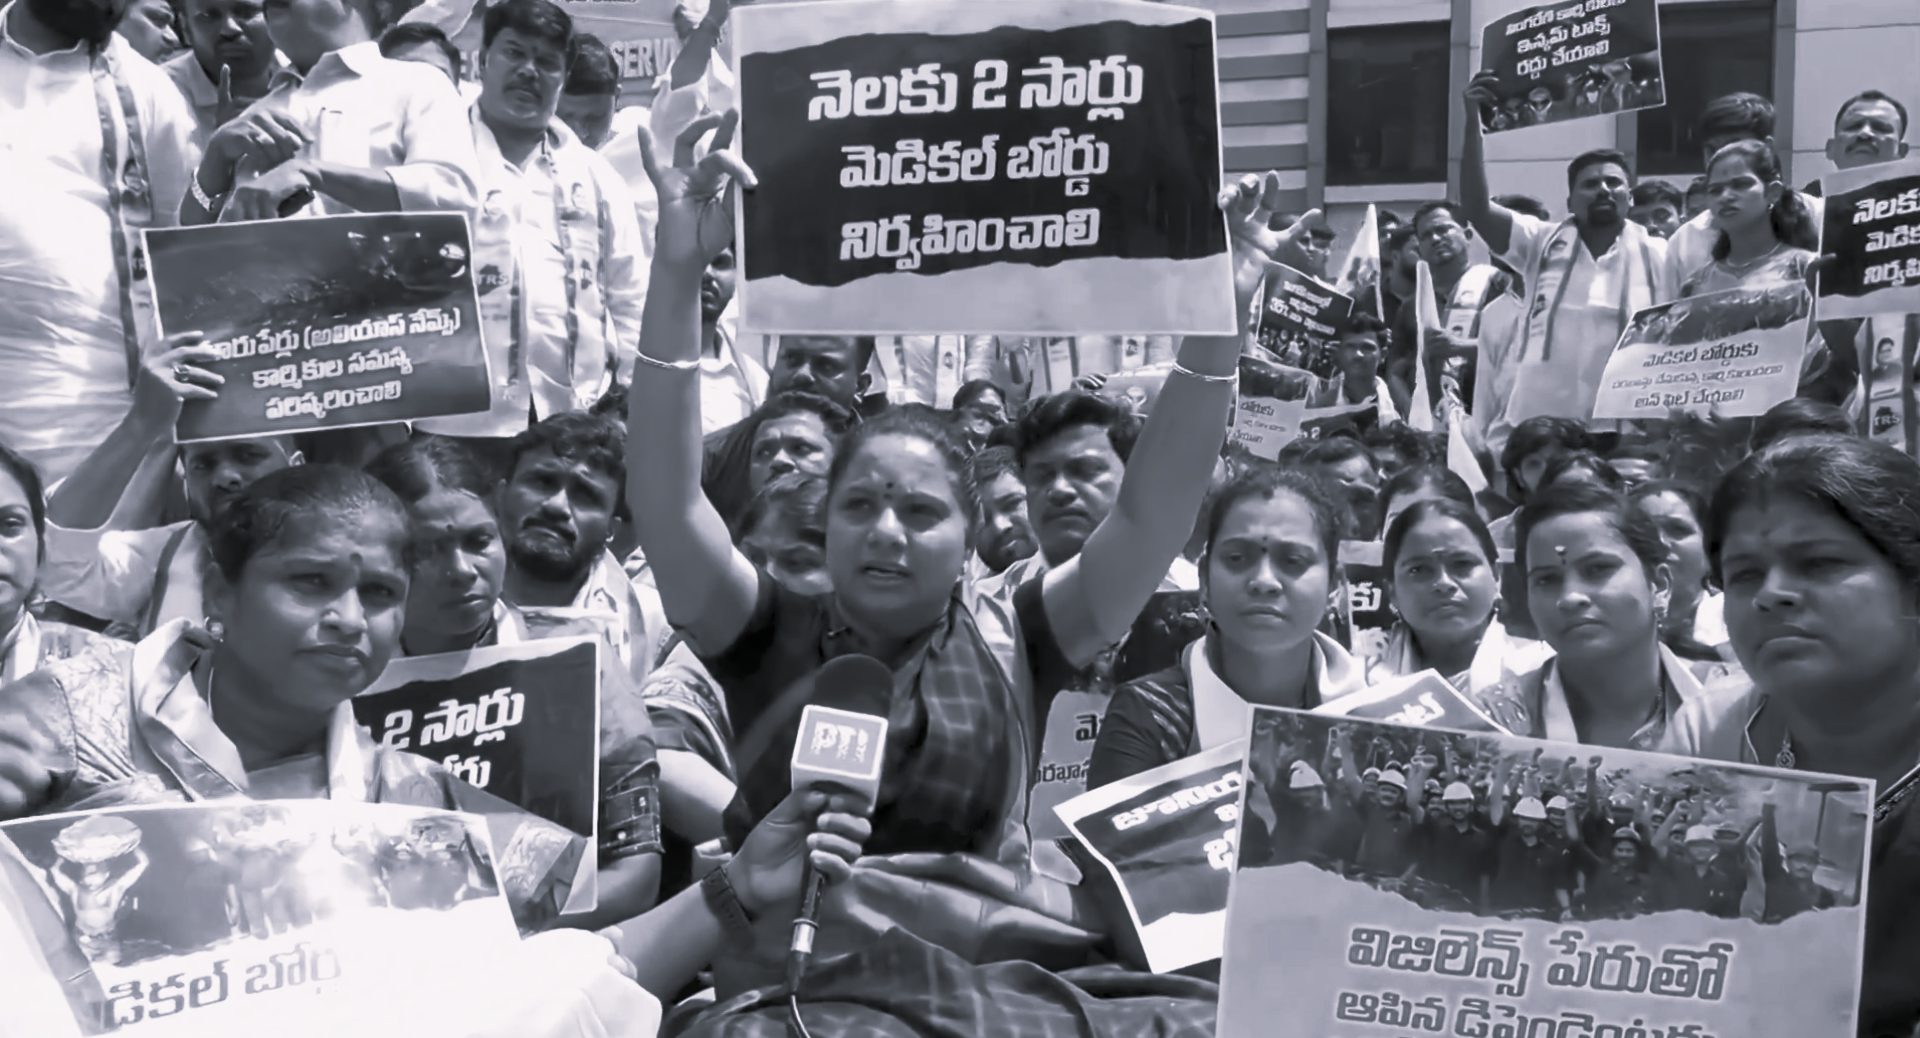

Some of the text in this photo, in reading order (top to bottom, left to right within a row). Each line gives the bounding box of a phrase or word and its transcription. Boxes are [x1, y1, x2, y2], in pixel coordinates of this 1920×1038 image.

[610, 38, 679, 77] SERVI
[1517, 40, 1609, 80] రద్దు చేయాలి
[808, 55, 1144, 121] నెలకు 2 సార్లు
[840, 127, 1109, 196] మెడికల్ బోర్డు
[839, 208, 1100, 270] నిర్వహించాలి
[252, 346, 413, 389] కార్మికుల సమస్య
[265, 380, 402, 419] పరిష్కరించాలి
[383, 709, 413, 750] 2
[420, 686, 525, 747] సార్లు
[1348, 927, 1733, 1000] విజిలెన్స్ పేరుతో
[1337, 992, 1446, 1031] ఆపిన
